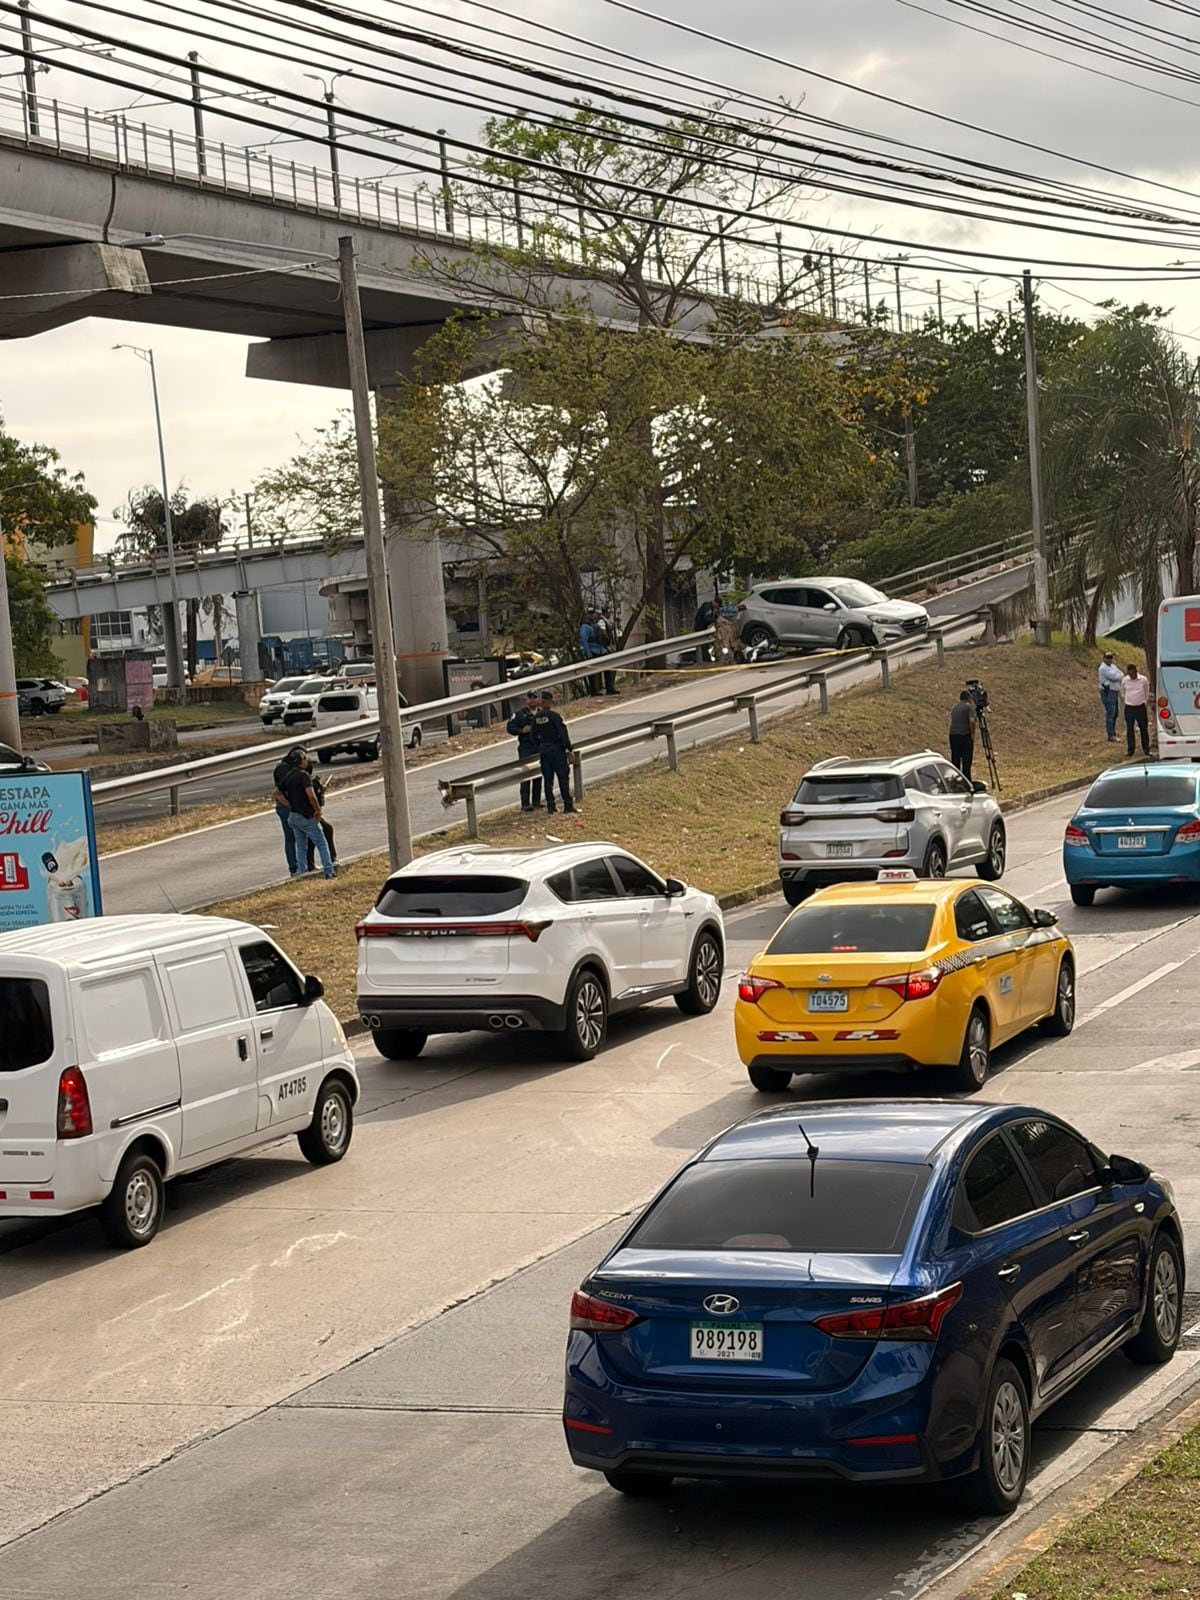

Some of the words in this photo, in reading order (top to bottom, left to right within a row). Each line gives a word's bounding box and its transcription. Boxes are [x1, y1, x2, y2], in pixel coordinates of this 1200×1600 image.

[430, 641, 441, 652] 22
[1179, 681, 1200, 689] DEST
[1, 802, 28, 811] GANA
[278, 1076, 307, 1101] AT4785
[599, 1290, 634, 1300] ACCENT
[696, 1329, 757, 1351] 989198
[717, 1350, 736, 1358] 2021
